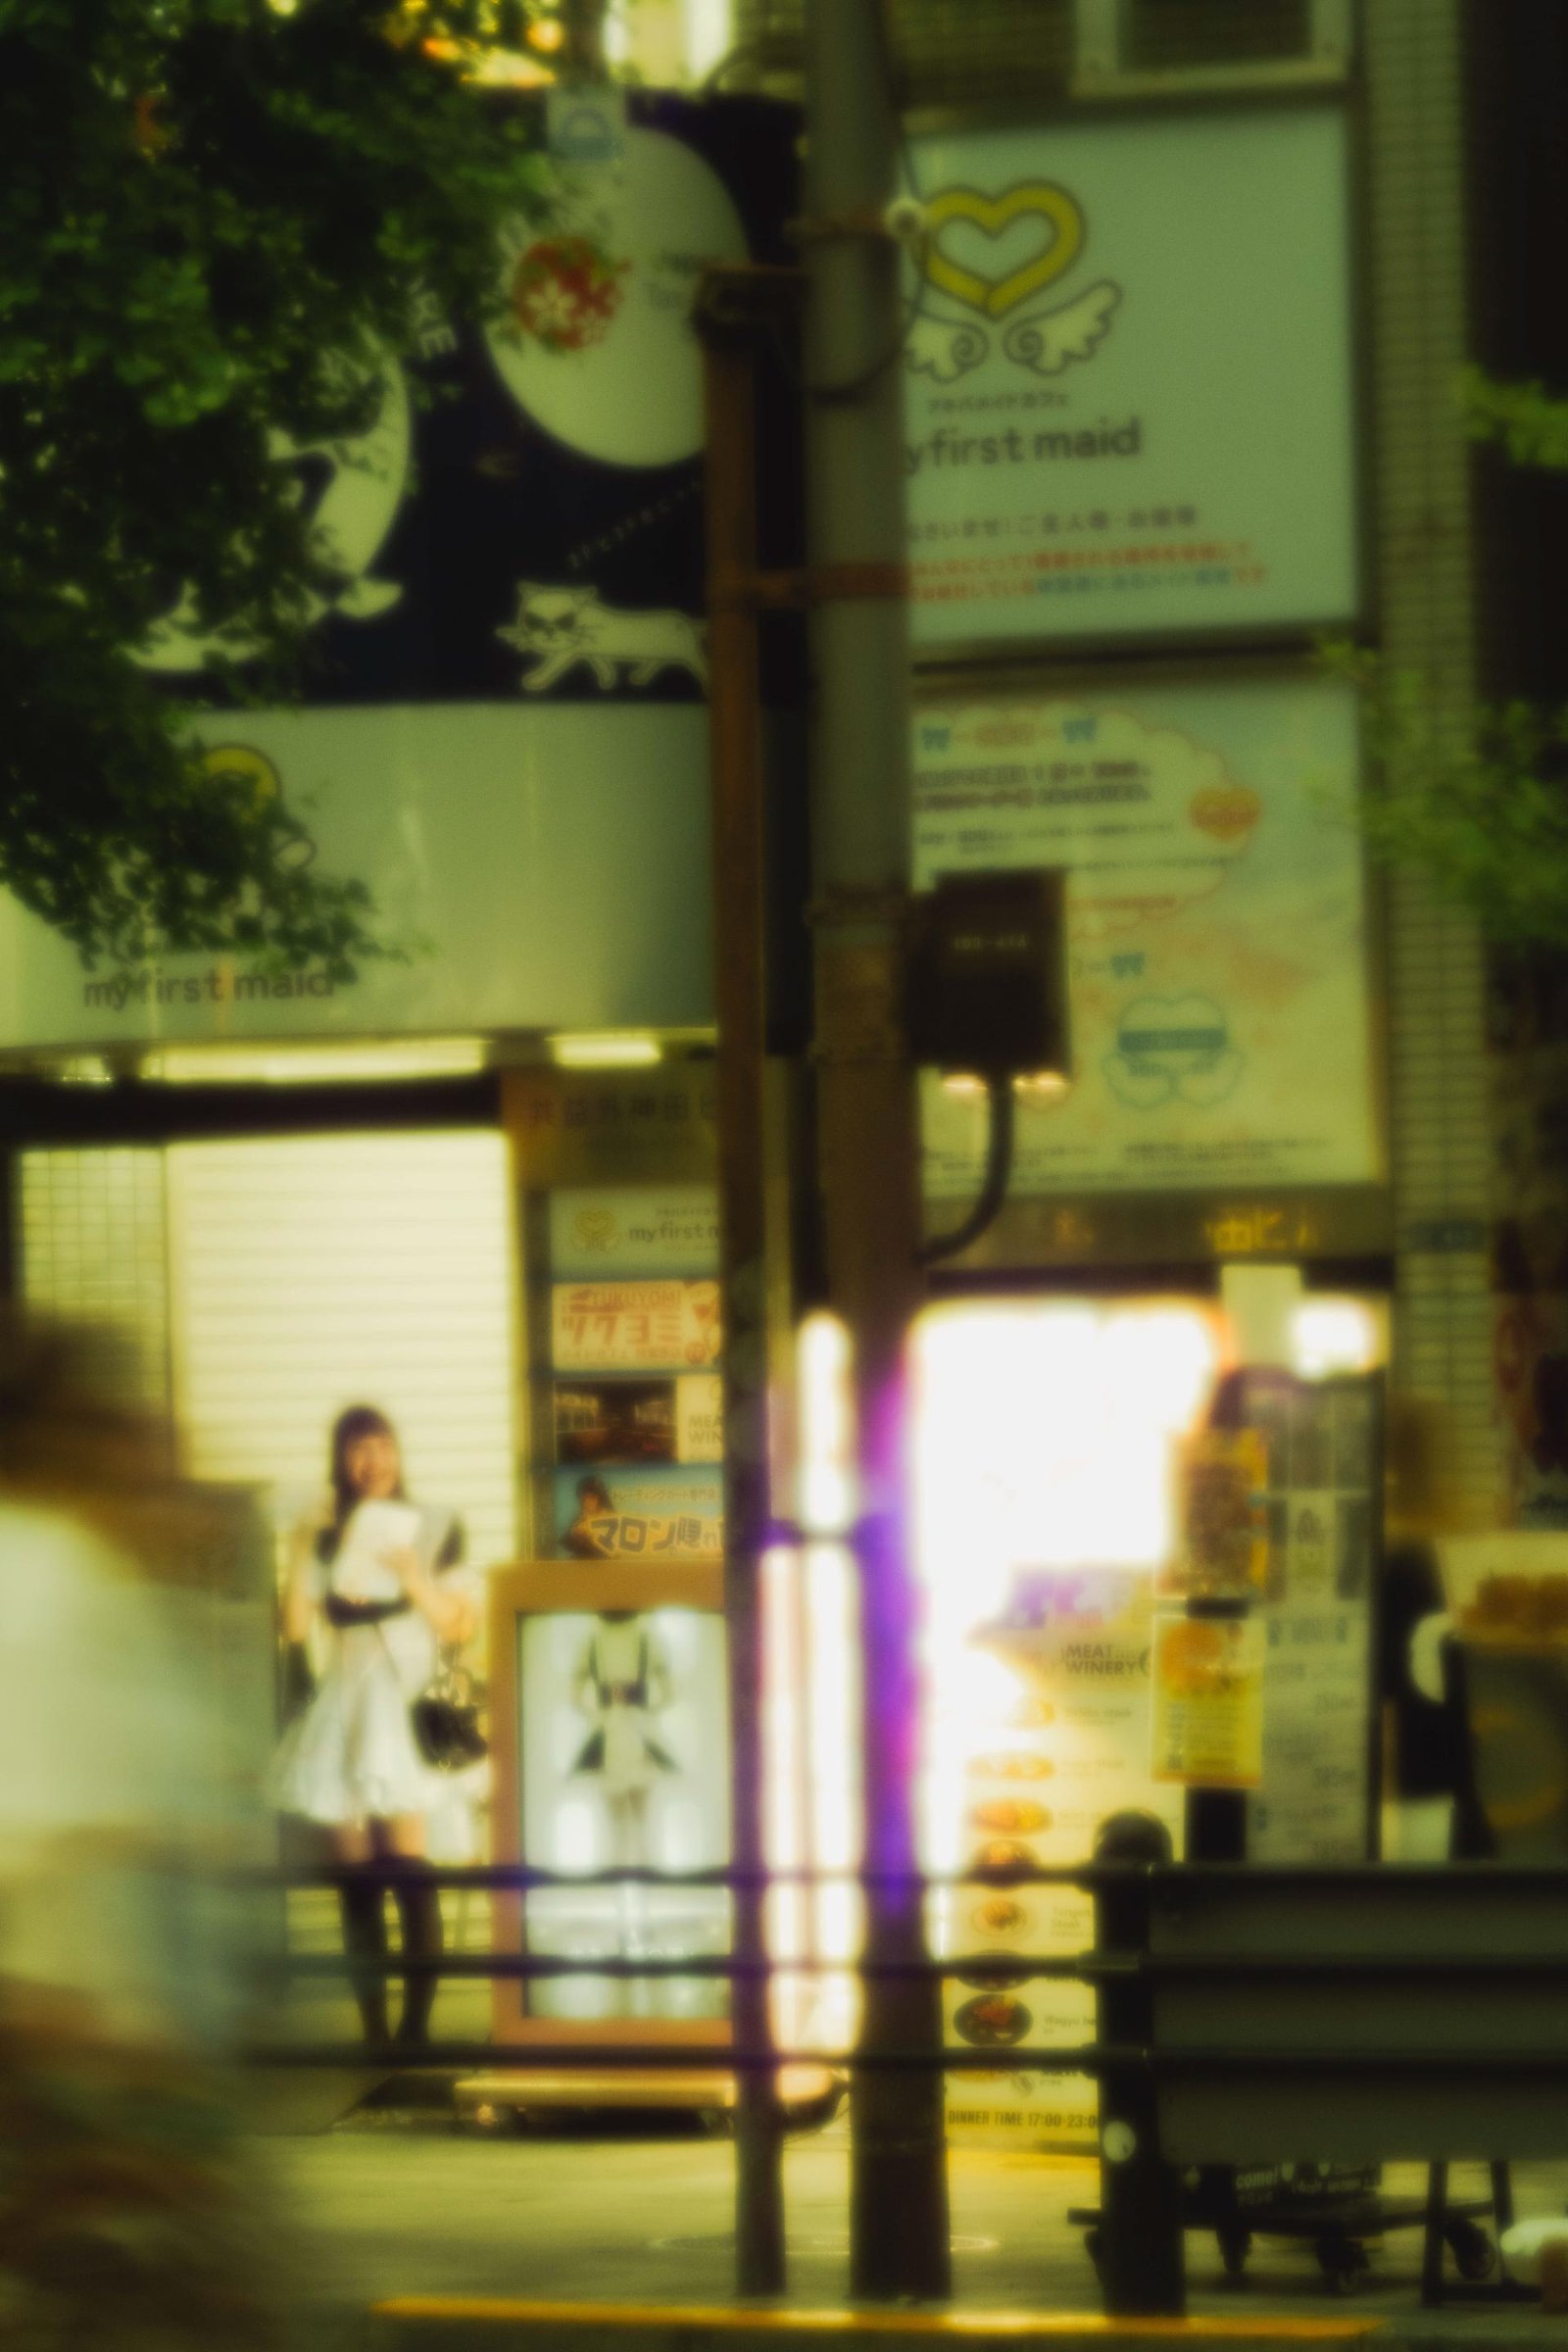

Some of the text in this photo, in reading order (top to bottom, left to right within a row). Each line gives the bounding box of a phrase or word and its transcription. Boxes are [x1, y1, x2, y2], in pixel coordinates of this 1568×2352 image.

[927, 427, 1024, 467] first
[1034, 415, 1141, 460] maid
[83, 976, 131, 1011] my
[629, 1227, 657, 1243] my
[660, 1220, 704, 1239] first
[561, 1313, 682, 1347] ツクヨミ
[1065, 1642, 1114, 1659] MEAT
[1065, 1660, 1138, 1676] WINERY
[947, 2109, 990, 2126] DINNER
[994, 2110, 1024, 2128] TIME
